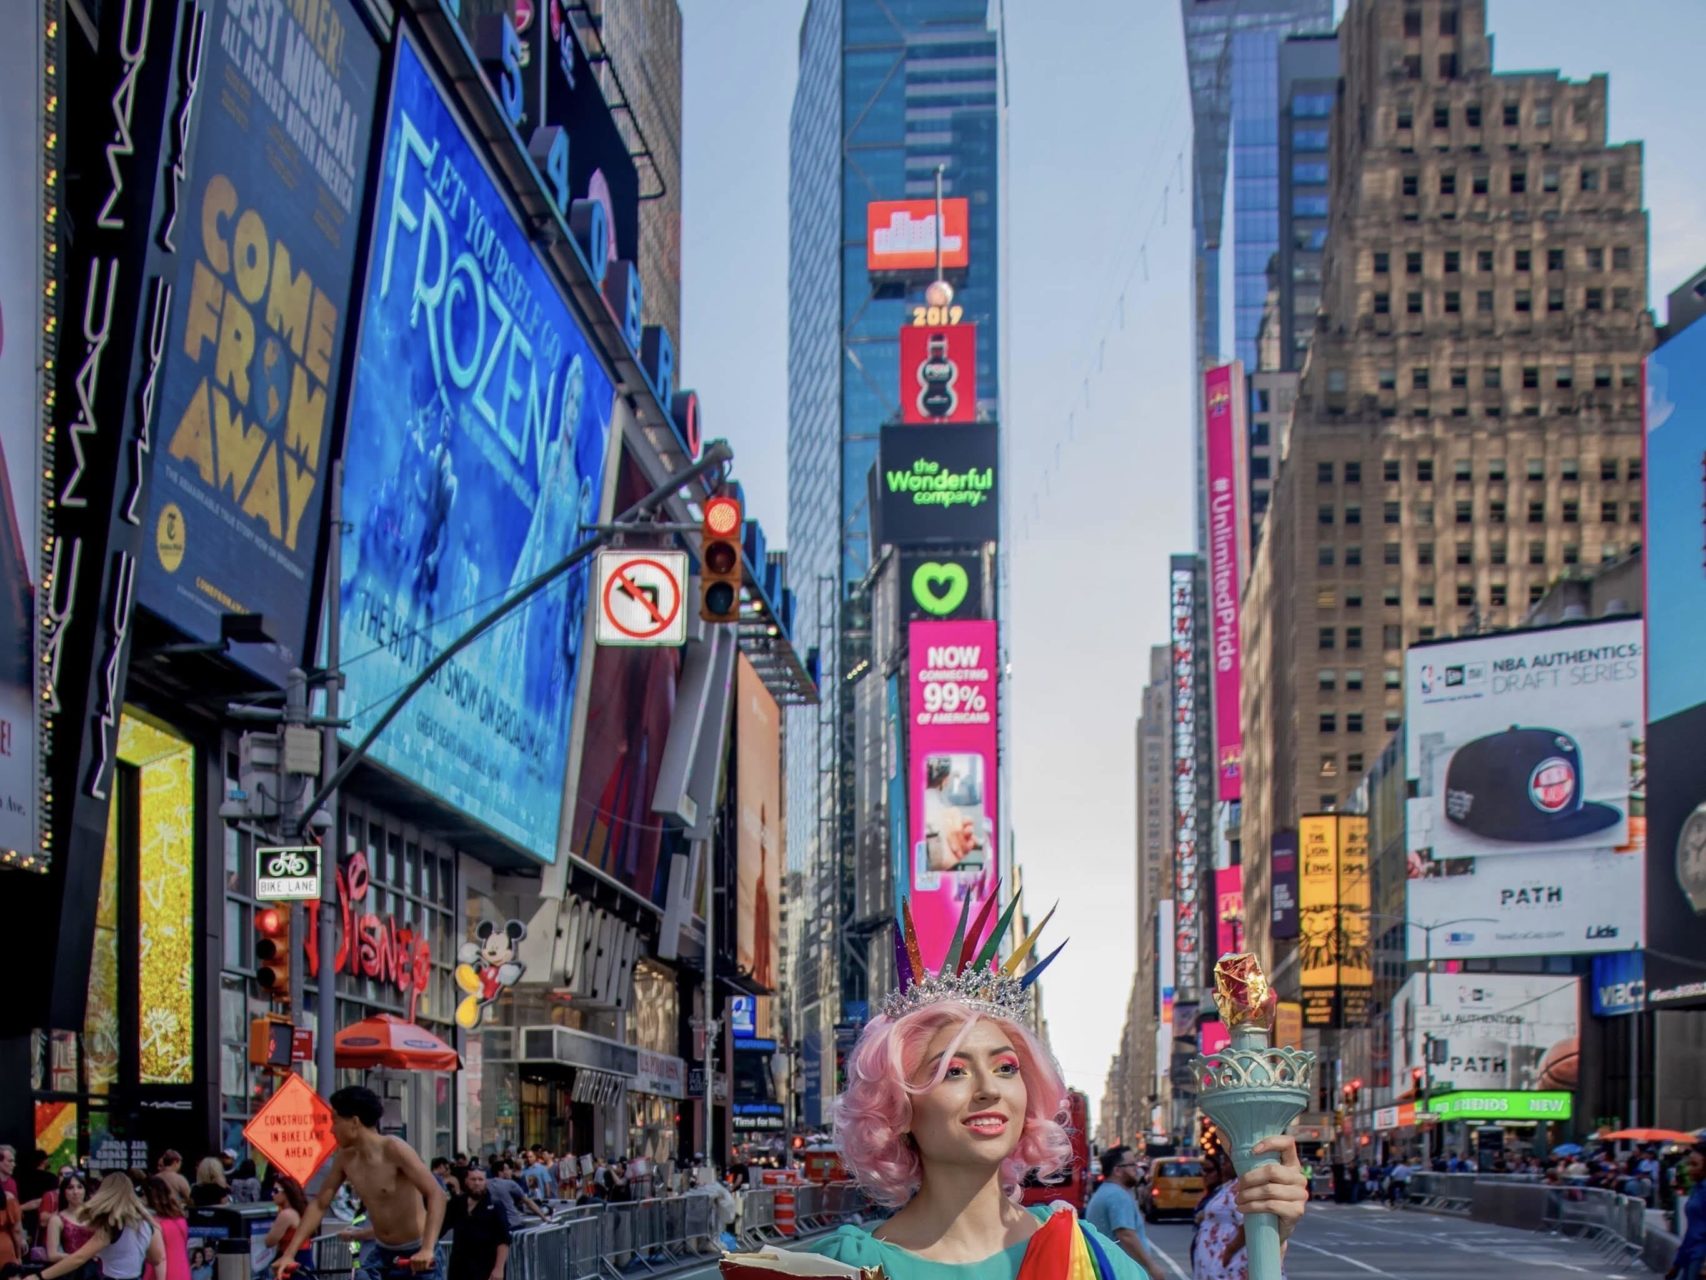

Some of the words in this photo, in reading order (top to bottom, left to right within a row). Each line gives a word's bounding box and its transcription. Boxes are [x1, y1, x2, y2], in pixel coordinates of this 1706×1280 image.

[220, 13, 242, 68] ALL
[243, 44, 287, 122] ACROSS
[281, 17, 358, 181] MUSICAL
[424, 138, 467, 220] LET
[465, 196, 543, 335] YOURSELF
[540, 319, 562, 366] GO
[202, 174, 338, 386] COME
[381, 109, 557, 487] FROZEN
[913, 305, 963, 327] 2019
[184, 259, 327, 476] FROM
[168, 376, 316, 551] AWAY
[914, 458, 939, 475] the
[887, 468, 993, 492] Wonderful
[1211, 476, 1237, 673] #UnlimitedPride
[360, 585, 388, 648] THE
[928, 645, 981, 668] NOW
[1492, 658, 1527, 674] NBA
[1492, 668, 1560, 696] DRAFT
[1570, 661, 1638, 687] SERIES
[923, 682, 987, 712] 99%
[260, 880, 282, 893] BIKE
[288, 879, 315, 892] LANE
[1500, 886, 1562, 905] PATH
[1450, 1056, 1507, 1073] PATH
[1529, 1099, 1564, 1112] NEW
[264, 1113, 328, 1126] CONSTRUCTION
[271, 1132, 279, 1142] IN
[281, 1131, 300, 1142] BIKE
[285, 1147, 314, 1158] AHEAD
